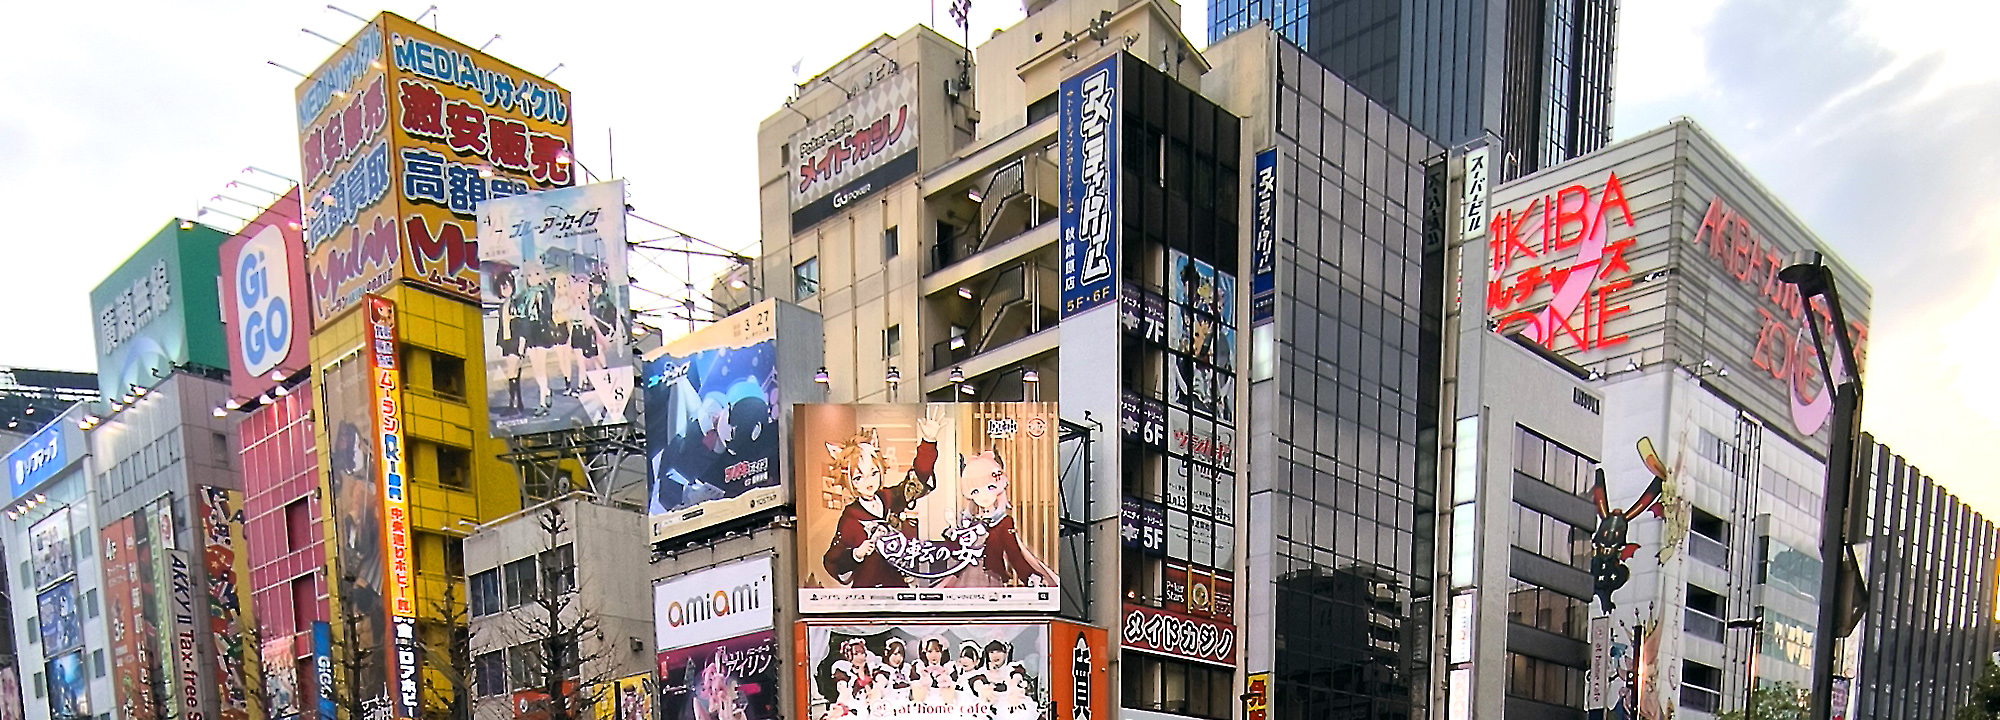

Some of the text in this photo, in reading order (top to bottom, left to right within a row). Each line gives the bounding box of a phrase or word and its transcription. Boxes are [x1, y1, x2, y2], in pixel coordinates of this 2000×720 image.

[392, 33, 568, 125] MEDIAリサイクル
[303, 73, 387, 182] 激安販売
[400, 79, 572, 185] 激安販売
[306, 139, 391, 252] 高額買取
[400, 147, 530, 217] 高額
[1468, 154, 1484, 232] スーパービル
[1486, 238, 1636, 312] ルチャーズ
[1693, 195, 1763, 286] AKIBA
[1145, 316, 1164, 343] 7F
[1494, 279, 1633, 353] ONE
[1144, 420, 1164, 446] 6F
[876, 525, 989, 572] 回転の宴
[1143, 525, 1163, 550] 5F
[668, 582, 760, 628] amiami
[1124, 610, 1234, 661] メイドカジノ
[179, 629, 199, 708] Tax-free
